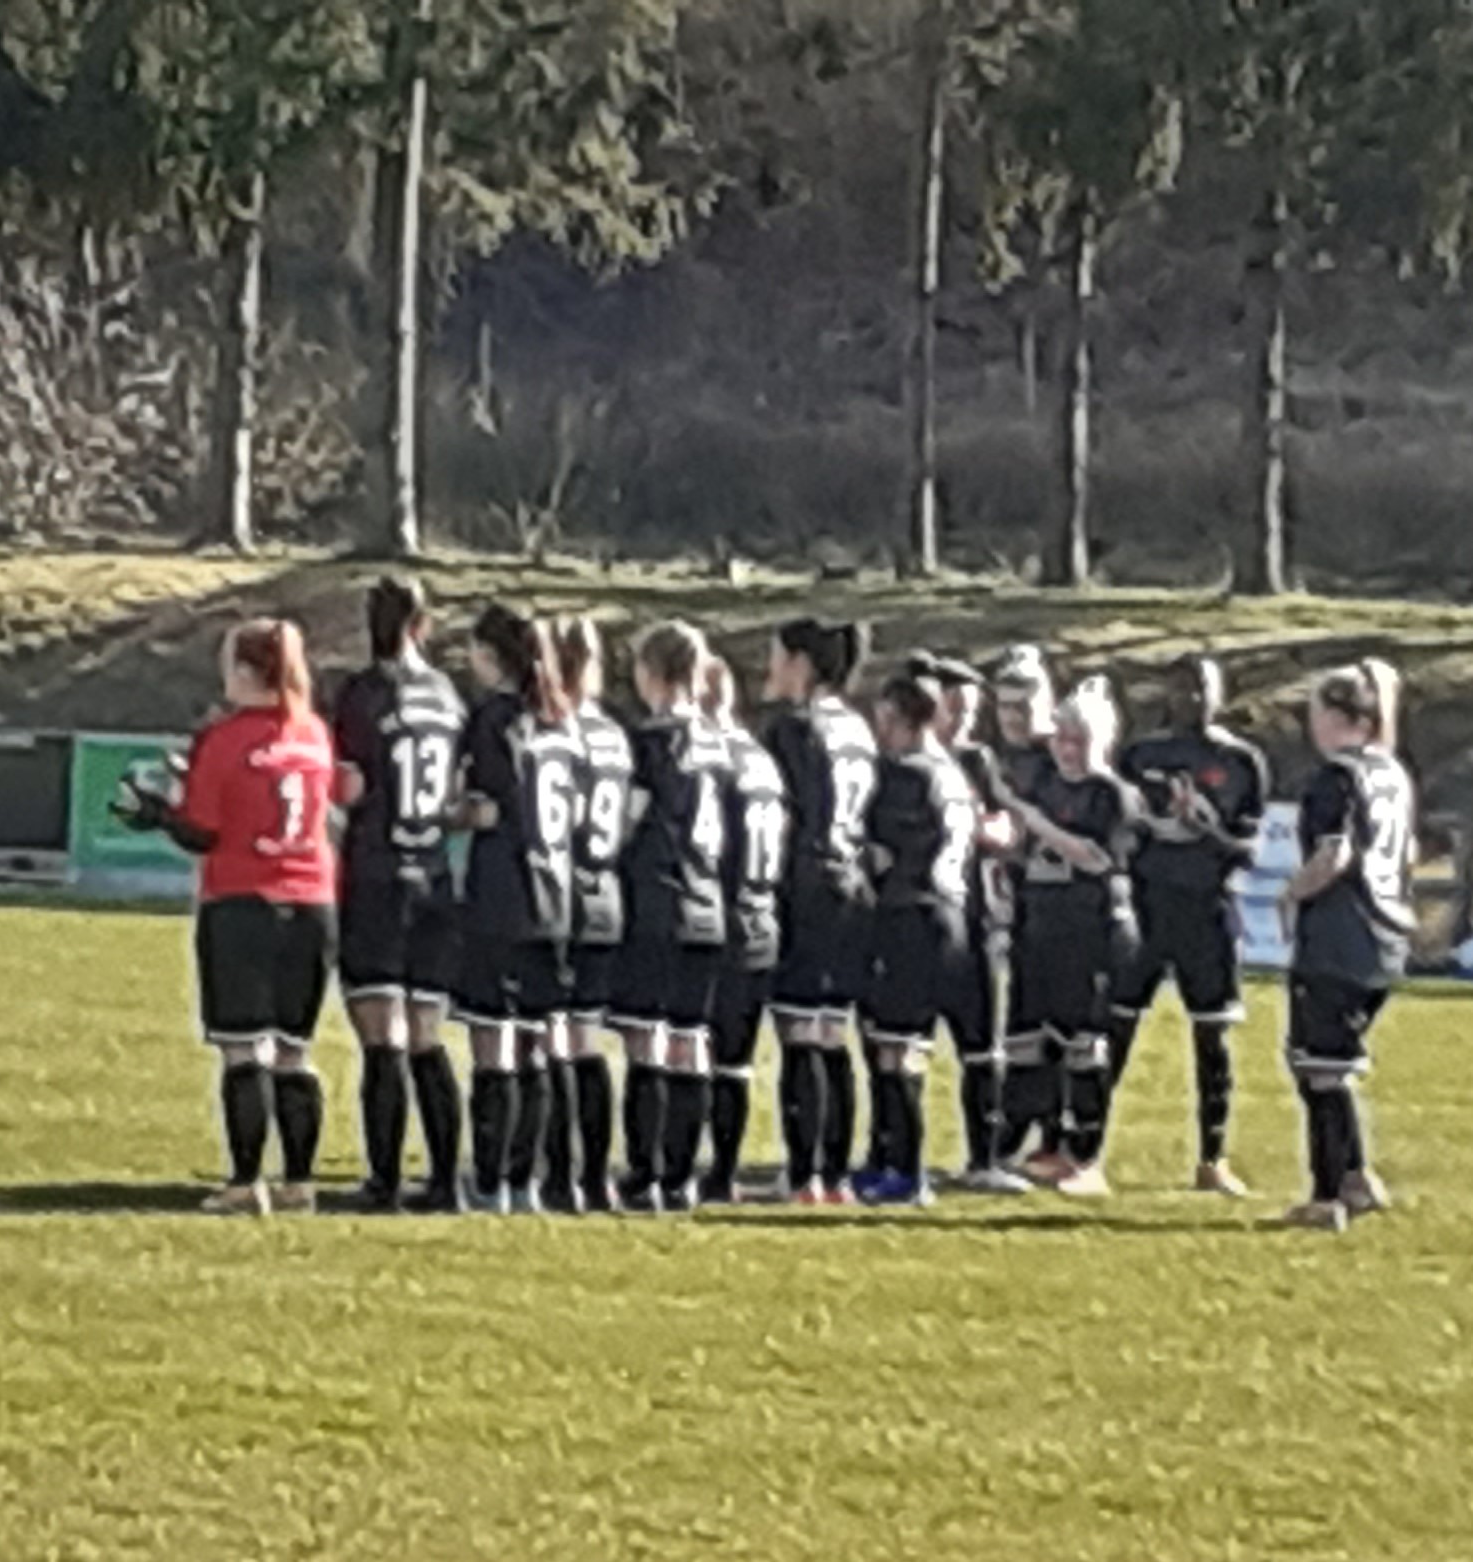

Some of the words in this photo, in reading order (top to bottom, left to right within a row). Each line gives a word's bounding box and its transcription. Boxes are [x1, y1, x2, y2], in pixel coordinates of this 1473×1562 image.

[280, 770, 306, 841] 1
[391, 736, 450, 818] 13
[537, 760, 569, 846] 6
[589, 778, 623, 860] 9
